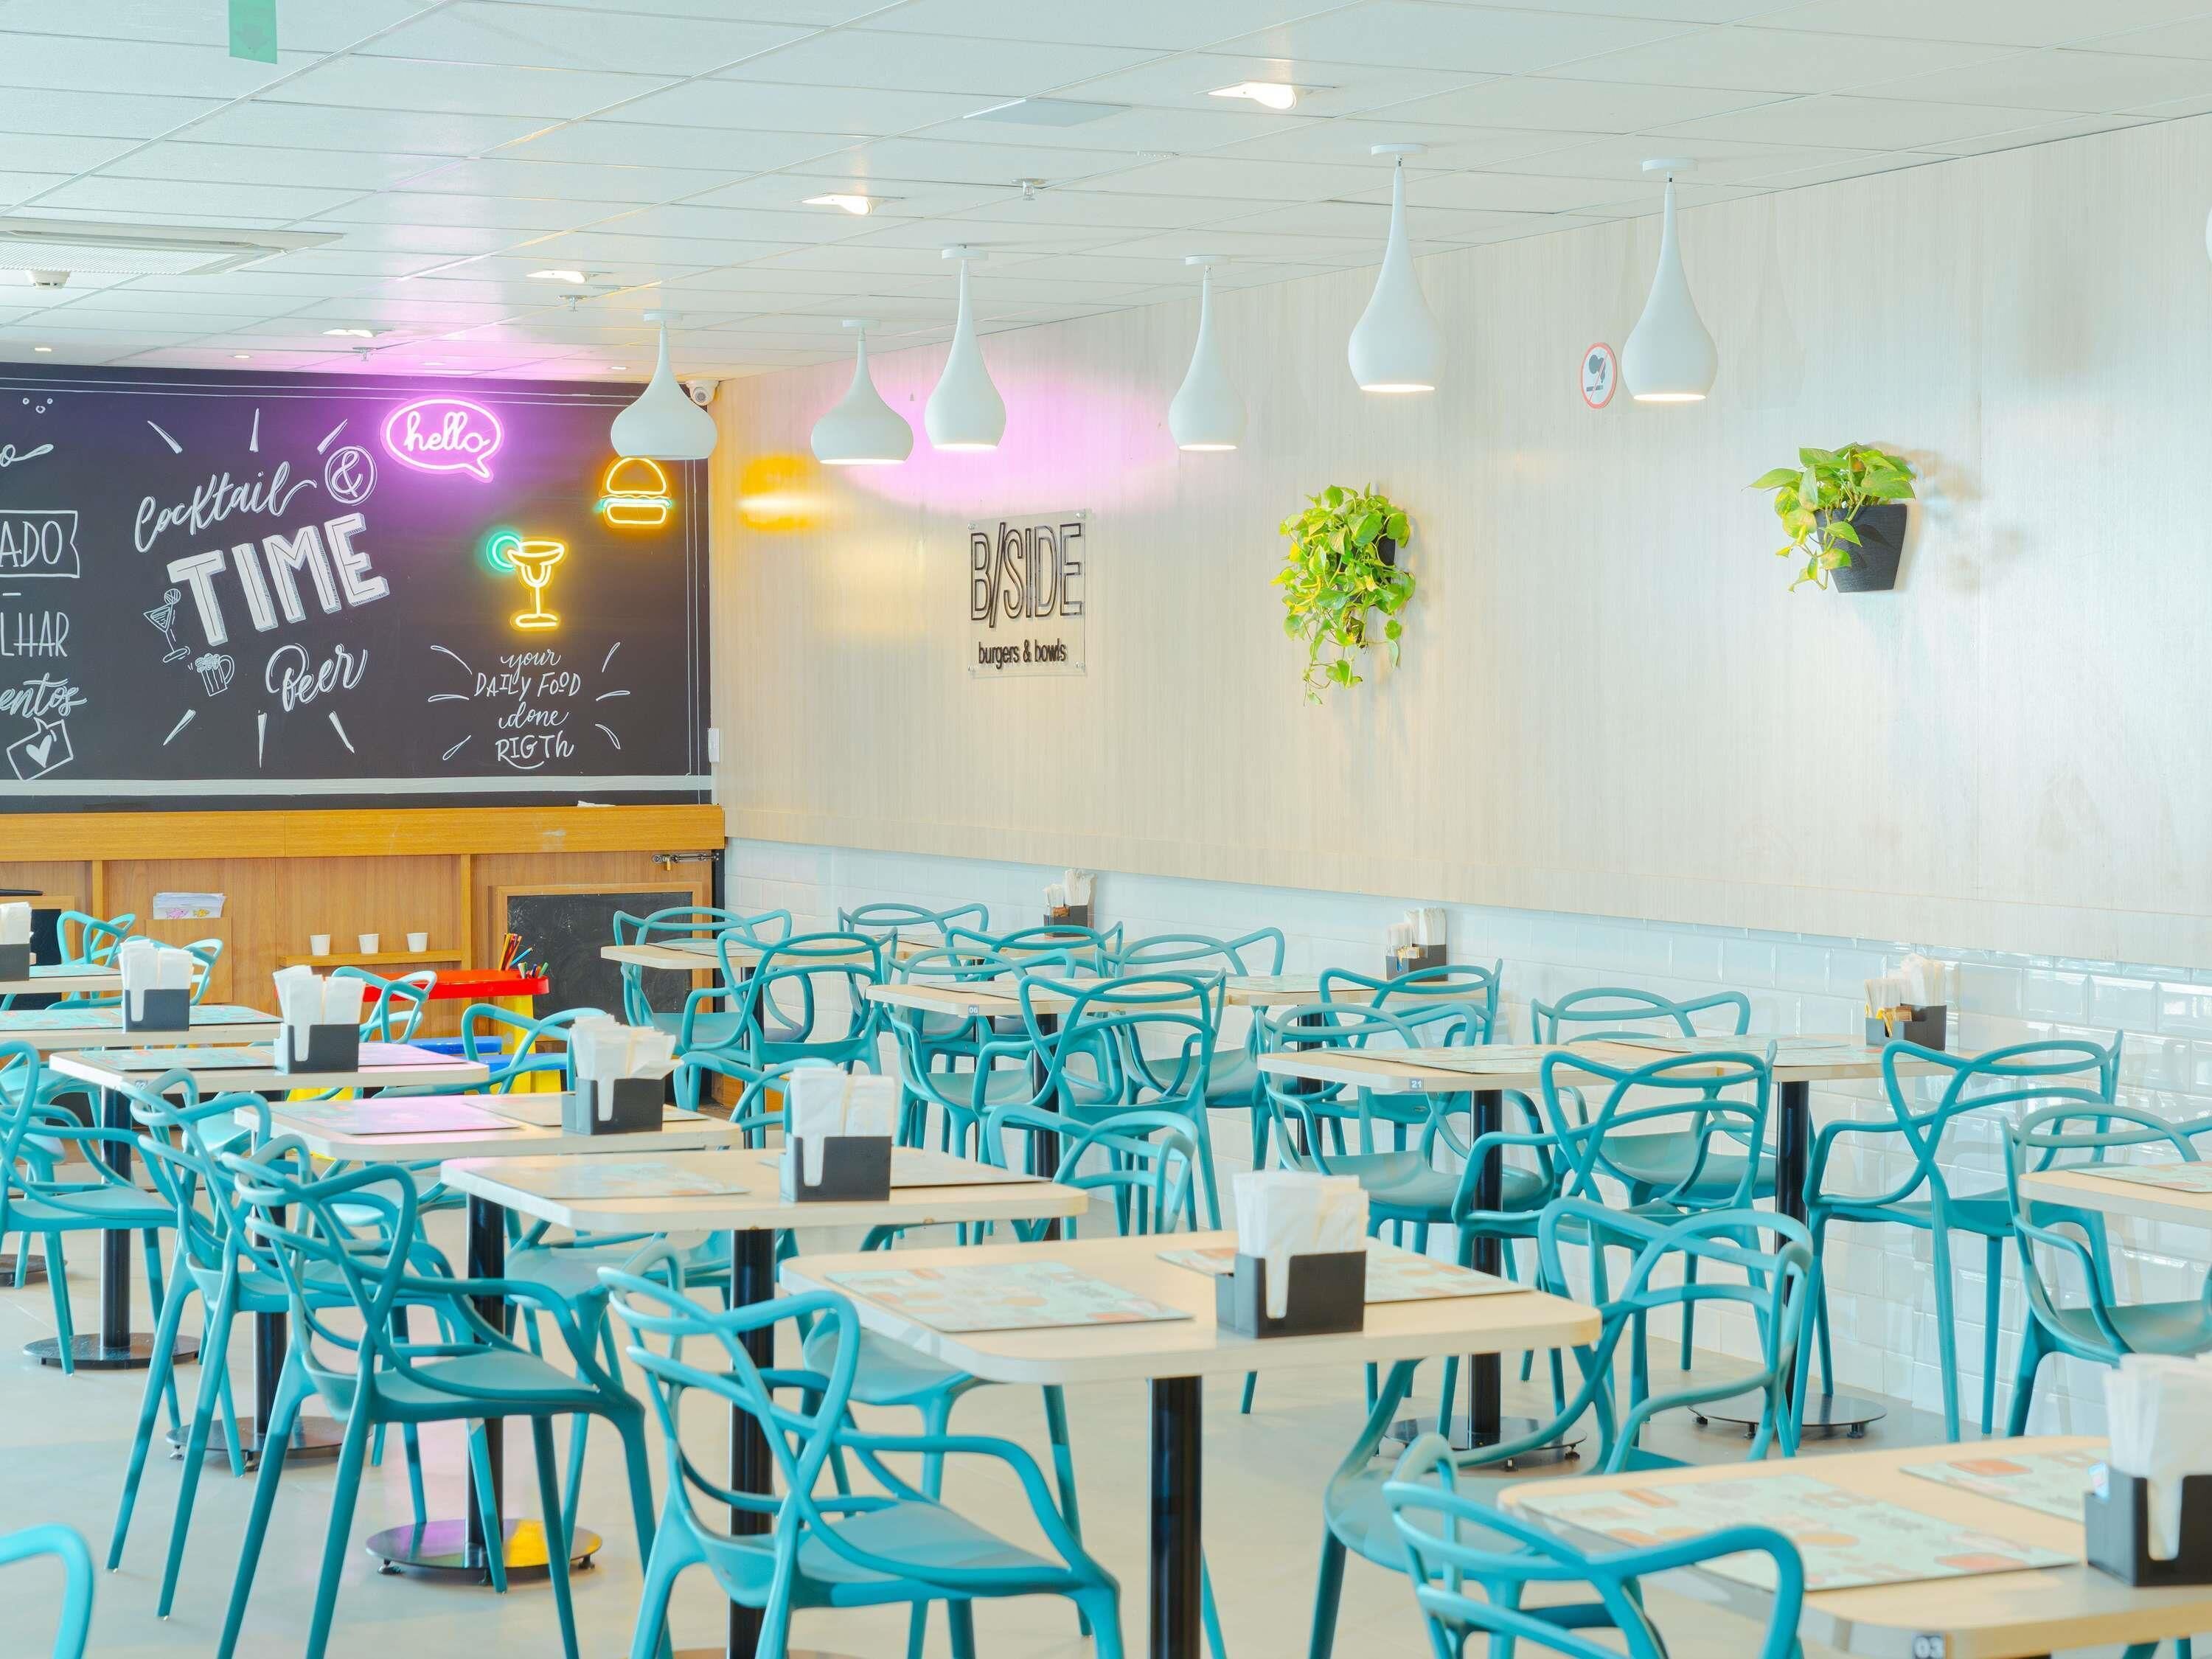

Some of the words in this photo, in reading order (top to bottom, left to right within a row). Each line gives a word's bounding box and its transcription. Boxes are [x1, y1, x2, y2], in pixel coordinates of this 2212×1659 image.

[404, 411, 490, 453] hello
[134, 461, 317, 552] Cocktail
[329, 448, 365, 500] &
[167, 512, 390, 647] TIME
[970, 521, 1082, 628] B/SIDE
[0, 611, 70, 658] LHAR
[978, 641, 1020, 669] burgers
[1023, 639, 1032, 663] &
[1034, 638, 1068, 663] bowls
[265, 644, 369, 712] Beer
[473, 672, 532, 702] DAILY
[500, 648, 562, 686] your
[0, 672, 88, 718] entos
[498, 702, 570, 728] done
